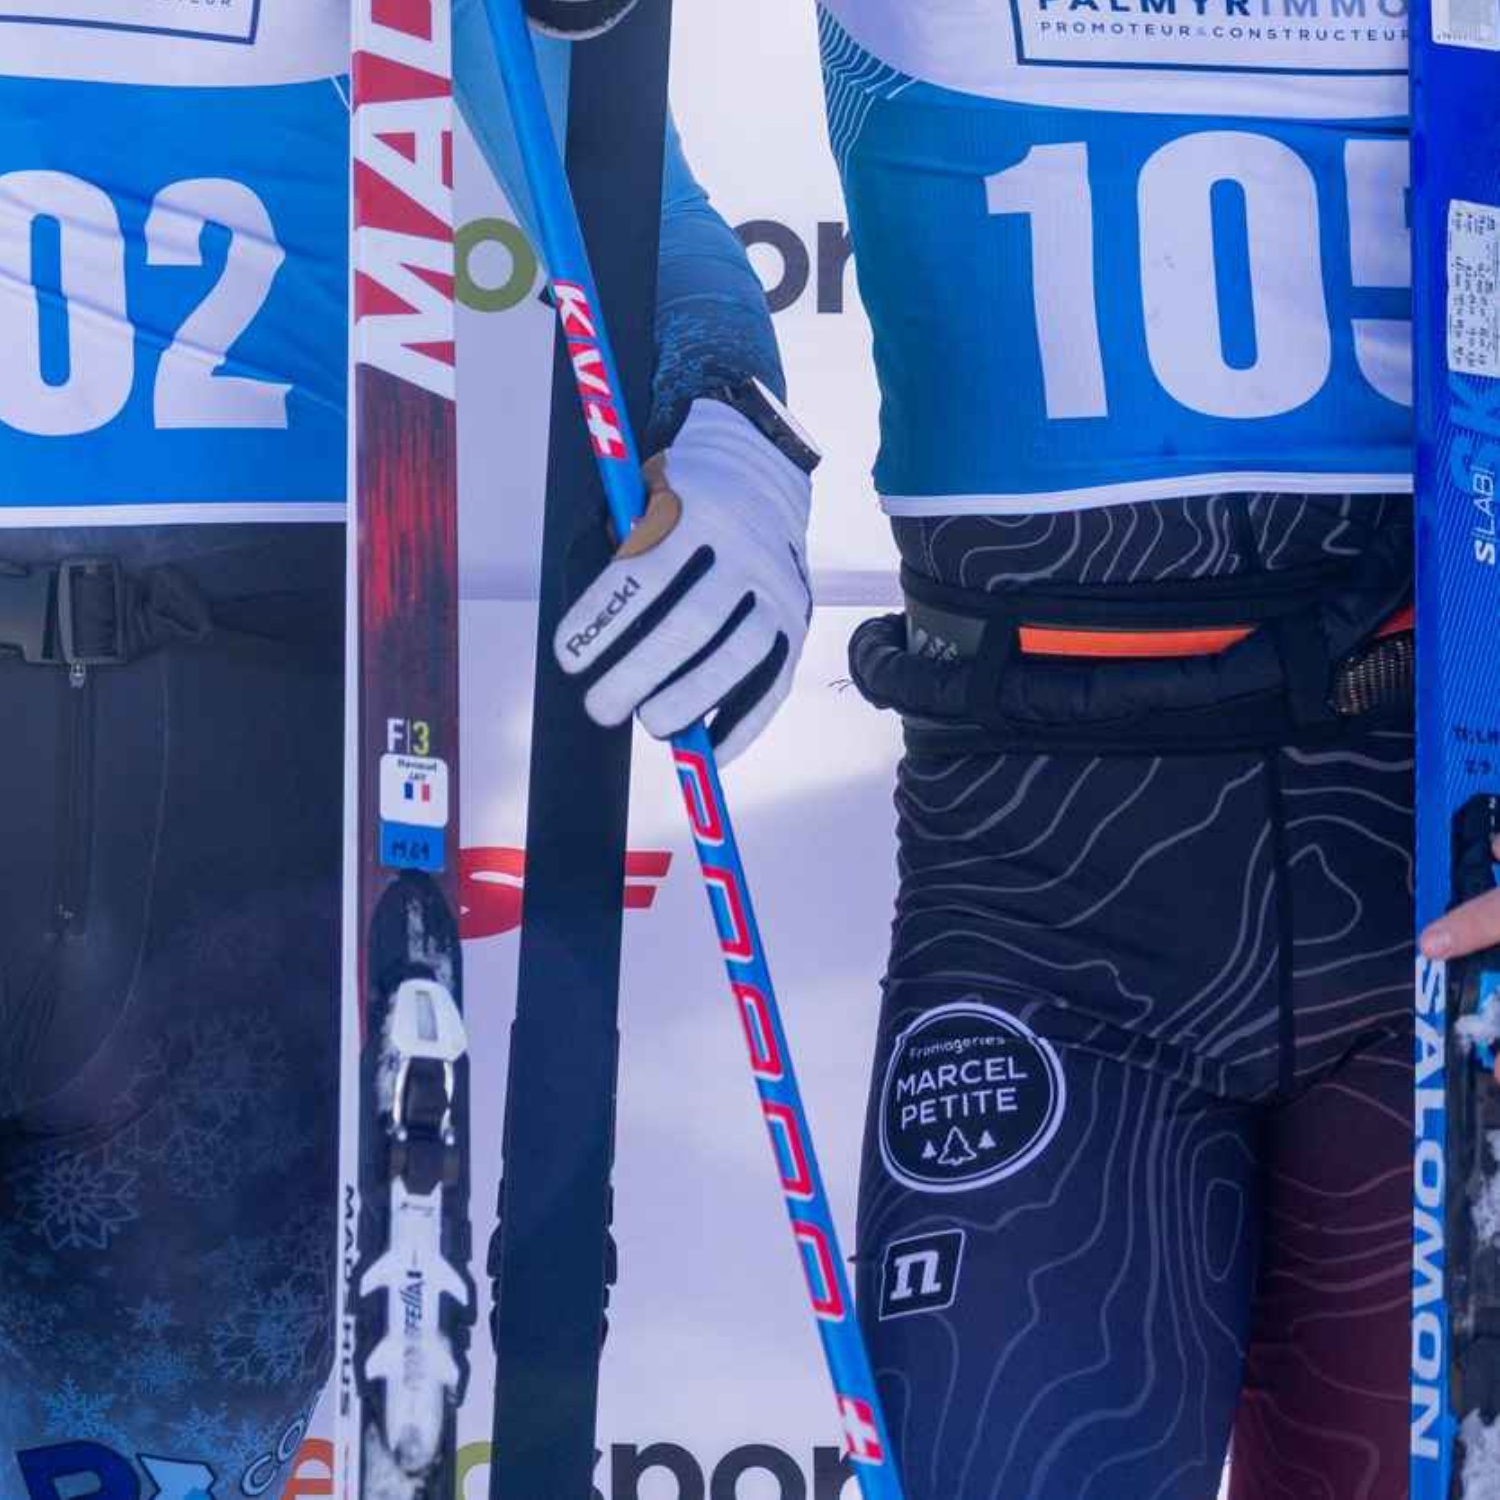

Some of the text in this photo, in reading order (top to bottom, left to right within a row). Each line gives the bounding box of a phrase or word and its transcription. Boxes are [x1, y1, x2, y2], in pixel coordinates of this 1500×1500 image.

[566, 576, 641, 658] Roeckl
[896, 1055, 1029, 1102] MARCEL
[901, 1087, 1019, 1130] PETITE
[1409, 955, 1447, 1460] SALOMON
